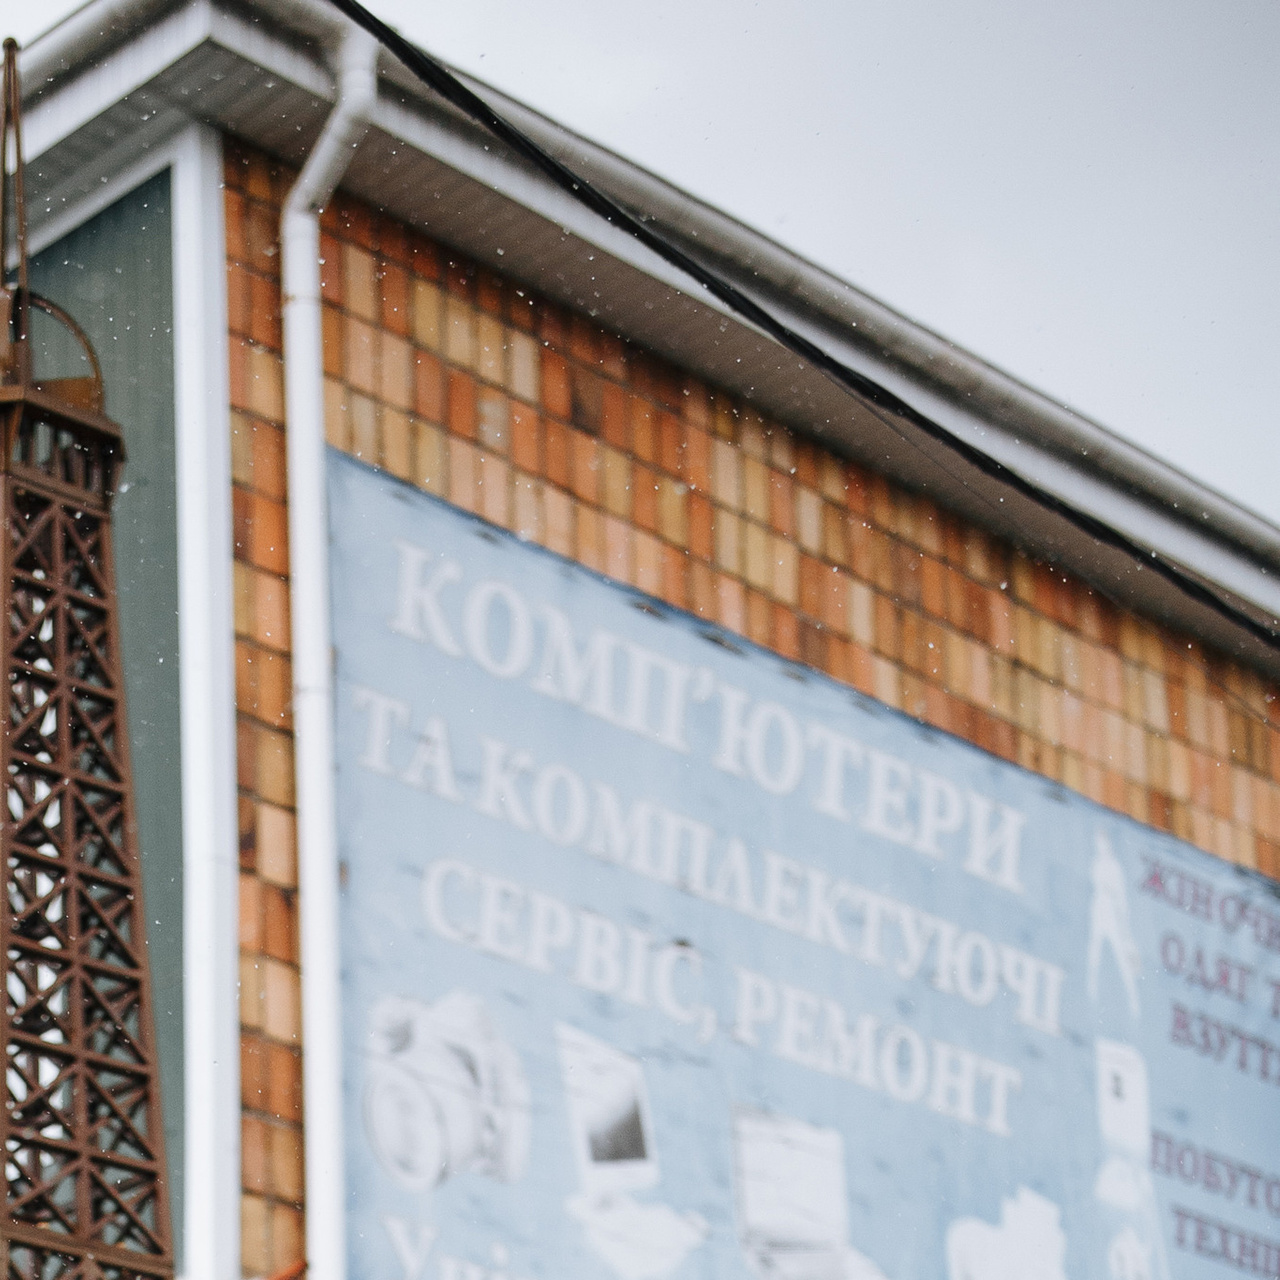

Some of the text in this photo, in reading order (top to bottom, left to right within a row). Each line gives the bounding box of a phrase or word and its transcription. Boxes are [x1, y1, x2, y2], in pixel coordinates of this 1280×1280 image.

[351, 686, 1068, 1038] ТА КОМПЛЕКТУЮЧІ
[387, 538, 1027, 893] КОМП'ЮТЕРИ
[419, 856, 1024, 1138] СЕРВІС, РЕМОНТ
[1159, 929, 1254, 1002] ОДЯГ
